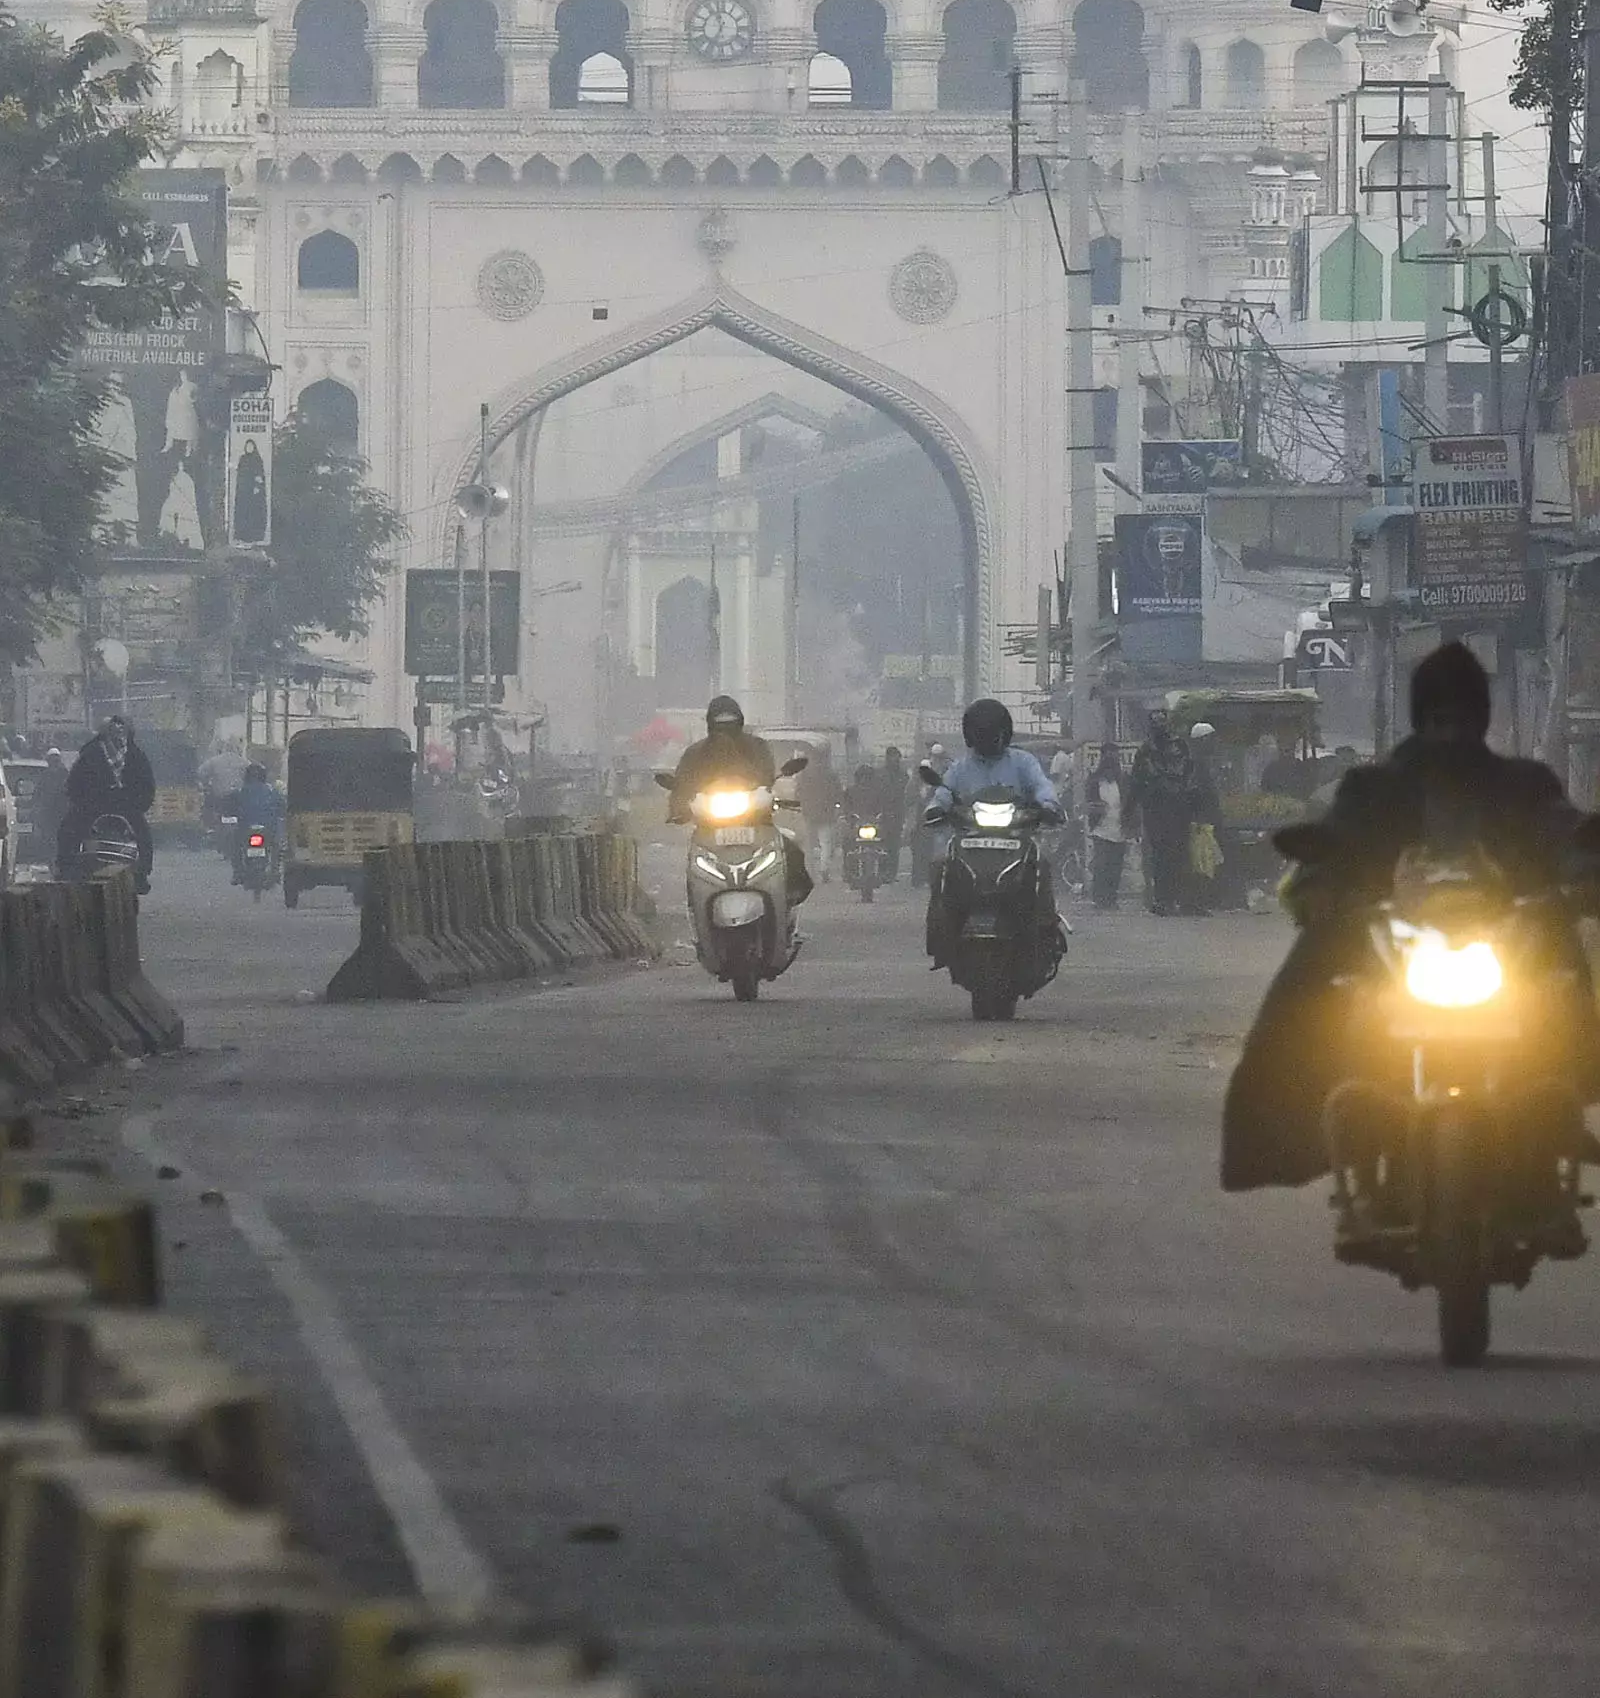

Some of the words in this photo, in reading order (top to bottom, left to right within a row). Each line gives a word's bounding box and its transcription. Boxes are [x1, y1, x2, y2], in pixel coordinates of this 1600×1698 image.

[86, 330, 143, 347] WESTERN
[146, 333, 187, 349] FROCK
[81, 348, 139, 365] MATERIAL
[142, 351, 206, 367] AVAILABLE
[232, 400, 271, 413] SOHA
[1419, 481, 1451, 508] FLEX
[1451, 479, 1520, 507] PRINTING
[1419, 509, 1519, 525] BANNERS
[1420, 586, 1449, 606] Cell:
